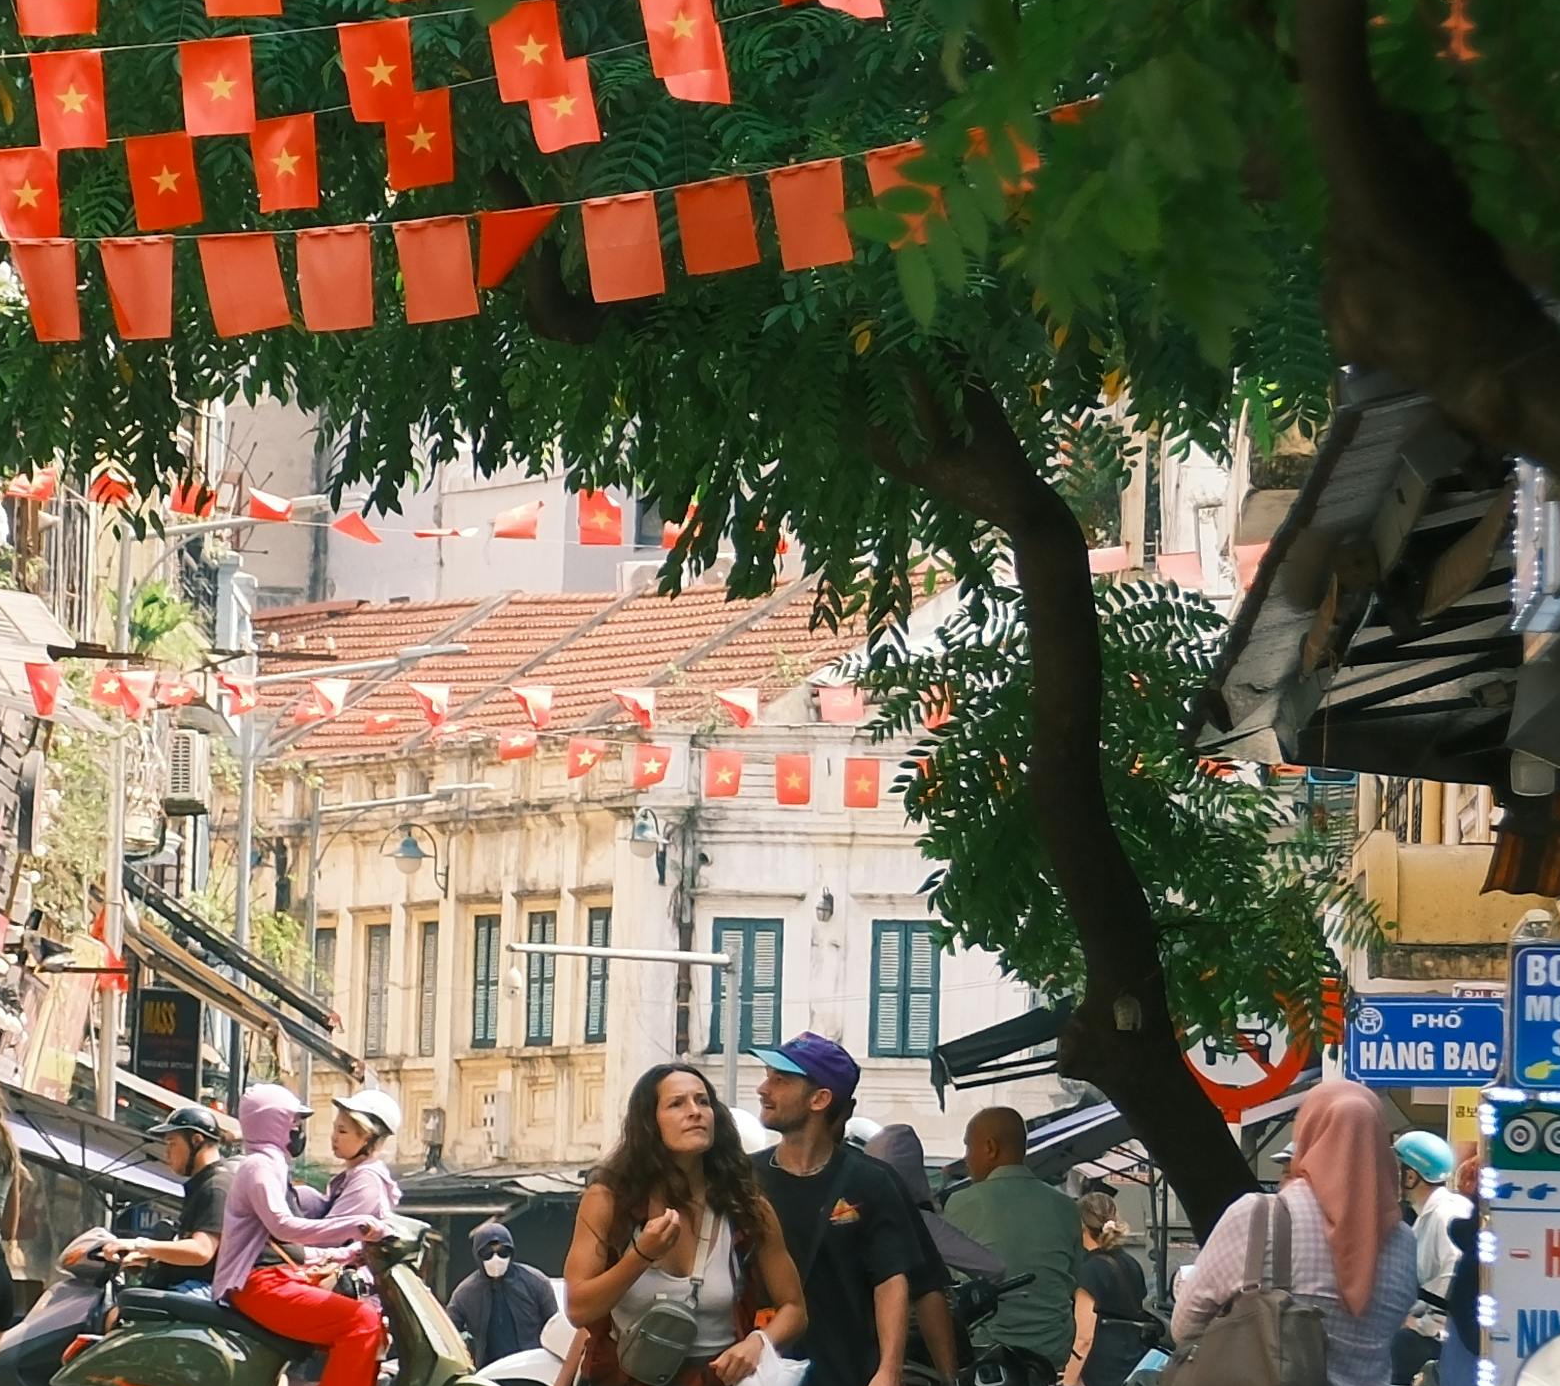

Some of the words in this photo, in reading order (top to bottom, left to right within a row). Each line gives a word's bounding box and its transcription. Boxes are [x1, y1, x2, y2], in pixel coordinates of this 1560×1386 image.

[1411, 1007, 1464, 1029] PHỐ
[1359, 1033, 1435, 1071] HÀNG
[1442, 1040, 1498, 1078] BẠC
